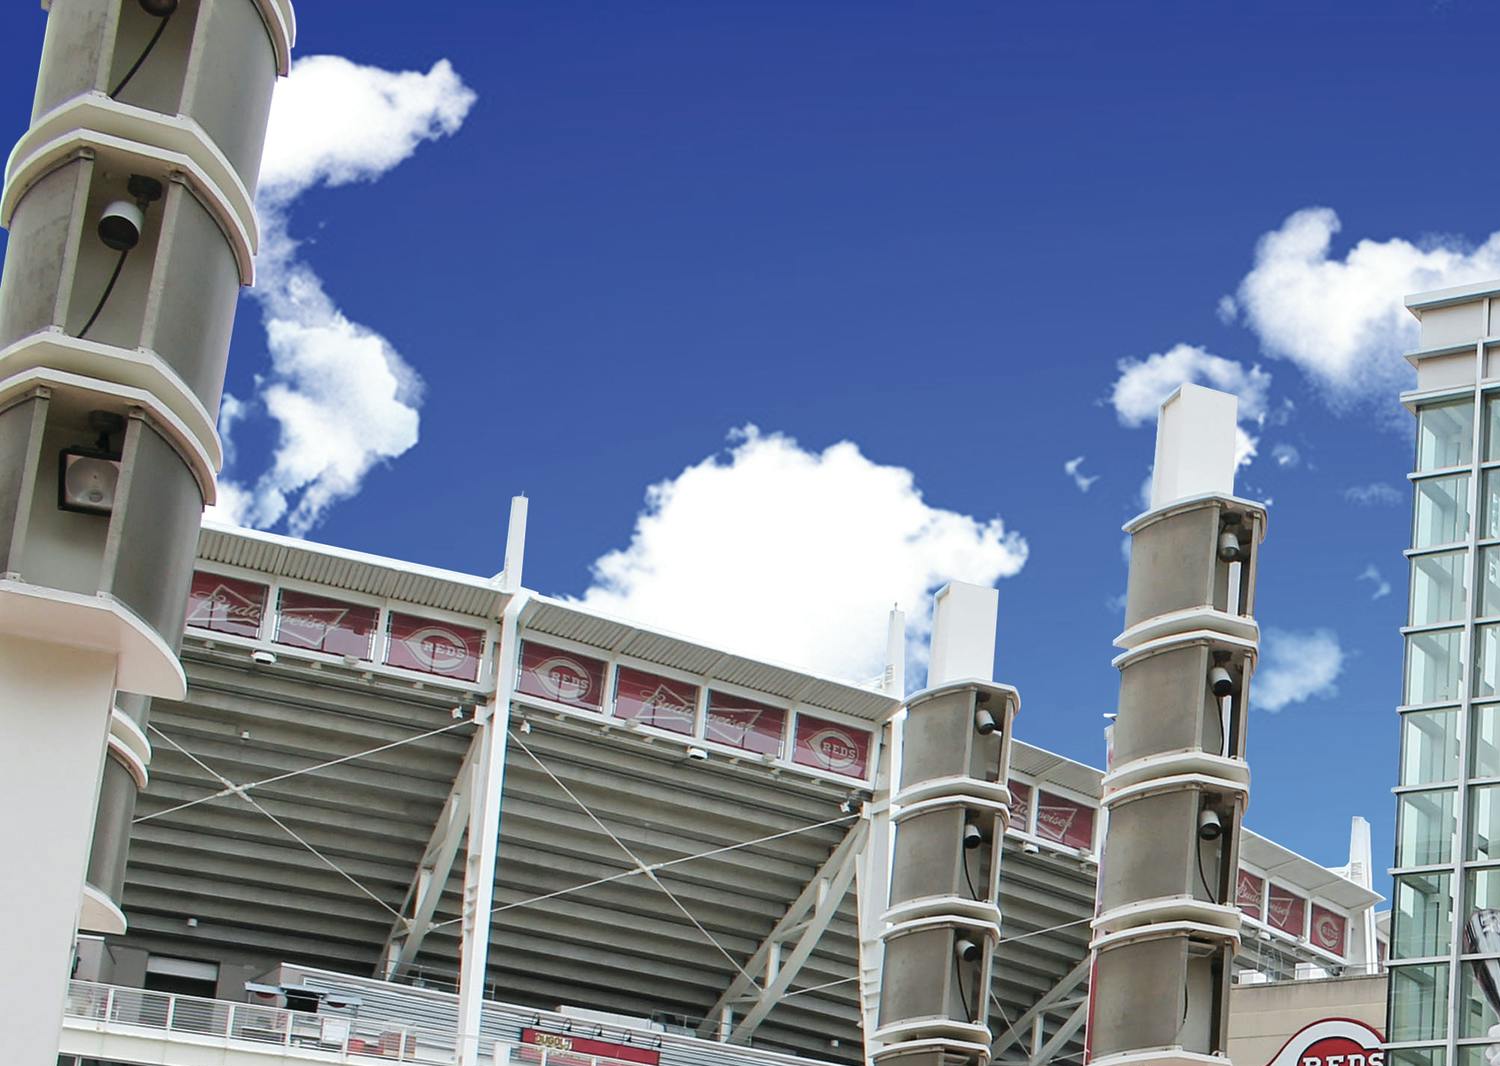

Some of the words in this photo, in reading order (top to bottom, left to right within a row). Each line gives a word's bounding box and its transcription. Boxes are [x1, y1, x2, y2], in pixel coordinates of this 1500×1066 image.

[424, 641, 466, 660] REDS
[551, 672, 590, 691] REDS
[822, 742, 858, 760] REDS
